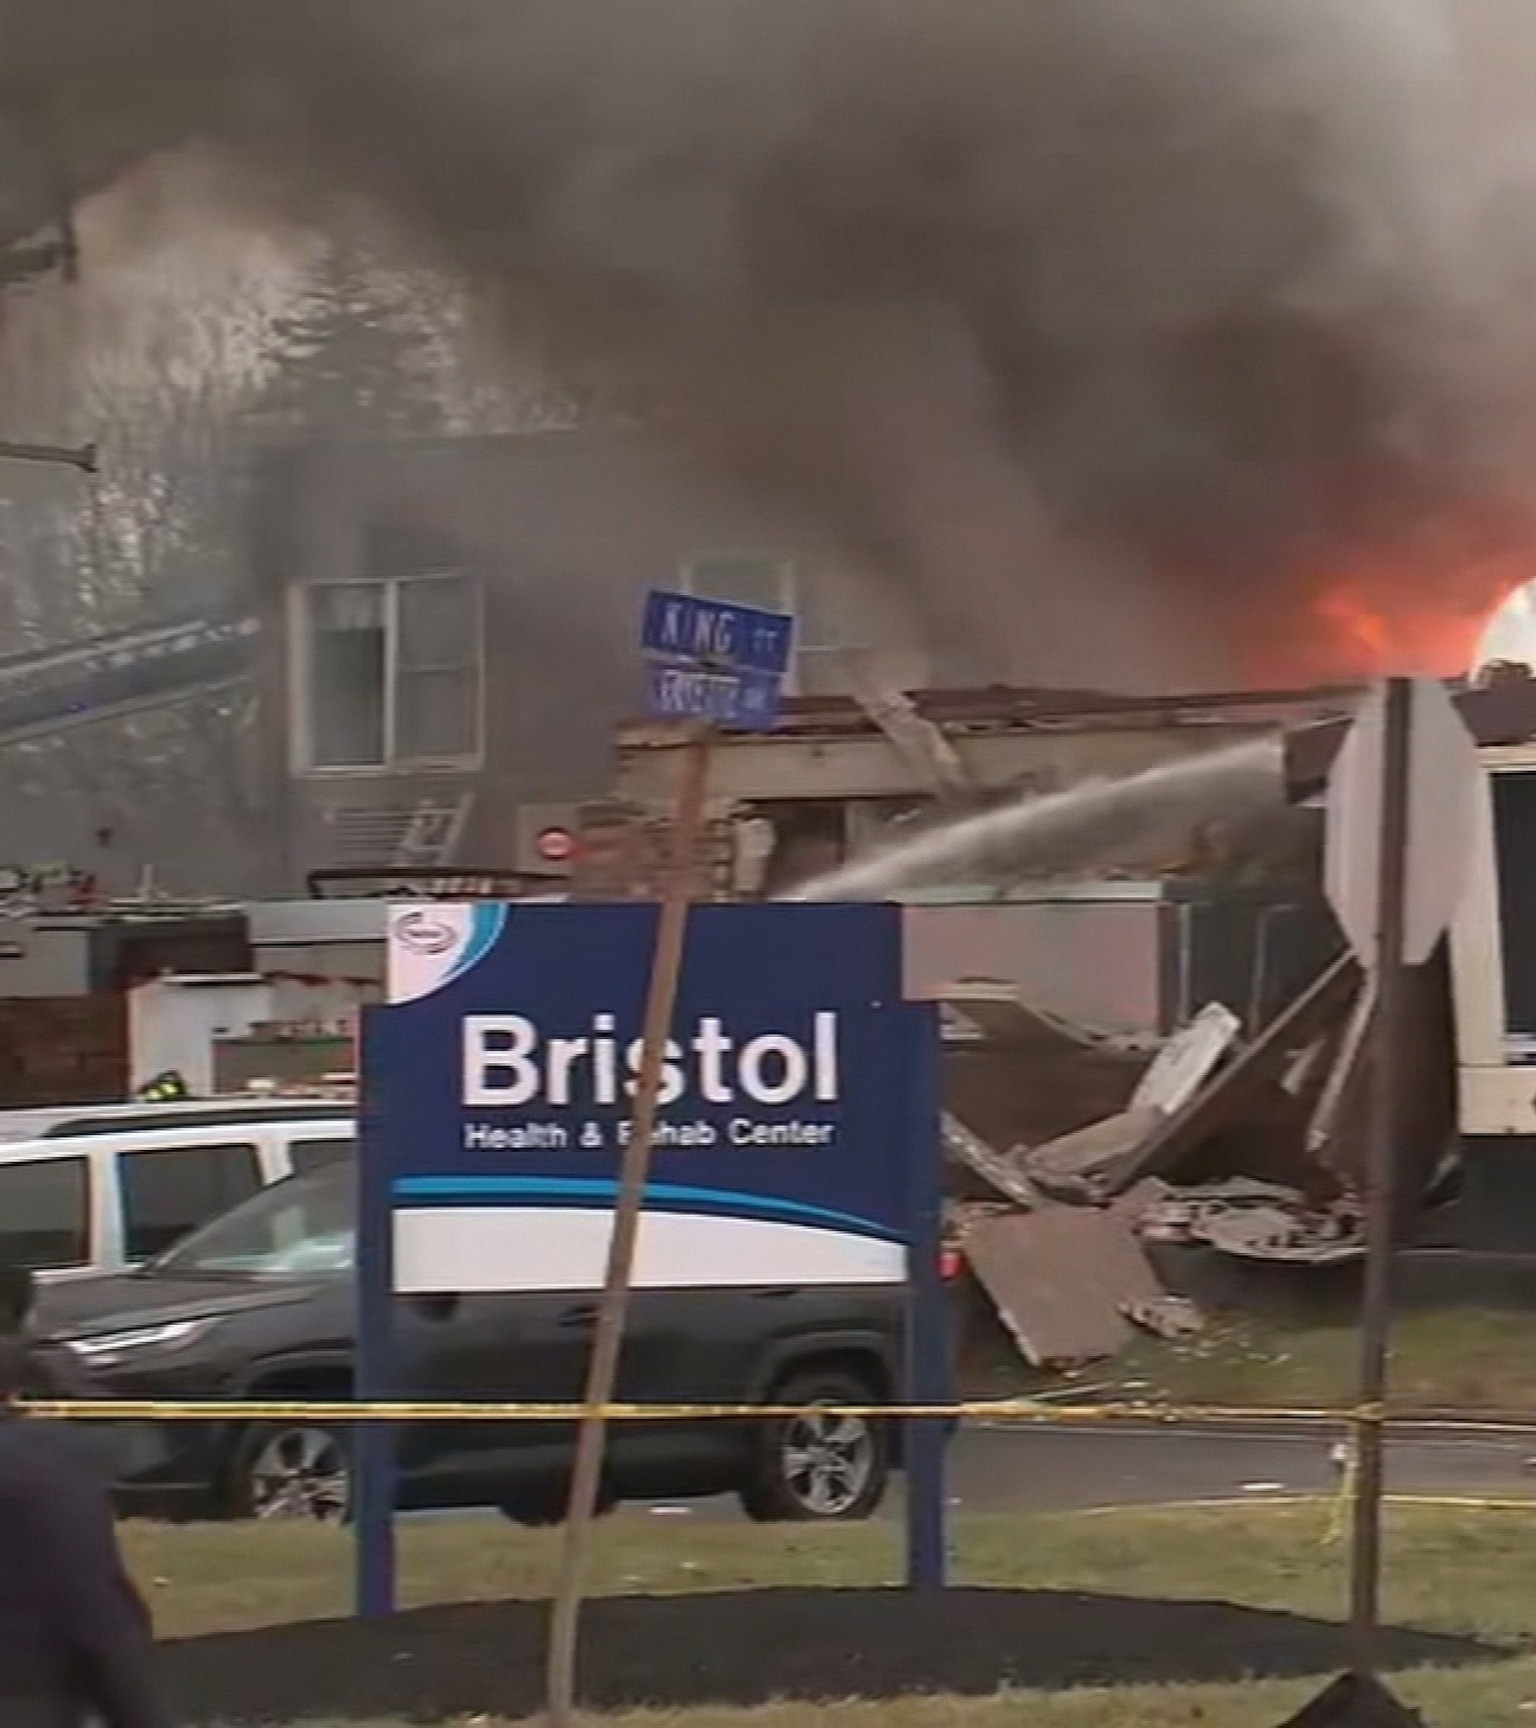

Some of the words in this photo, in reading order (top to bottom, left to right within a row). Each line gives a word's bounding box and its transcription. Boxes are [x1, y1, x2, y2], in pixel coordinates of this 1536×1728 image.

[660, 602, 734, 653] KING
[462, 1013, 838, 1104] Bristol
[465, 1123, 568, 1149] Health
[580, 1121, 603, 1147] &
[729, 1118, 834, 1146] Center
